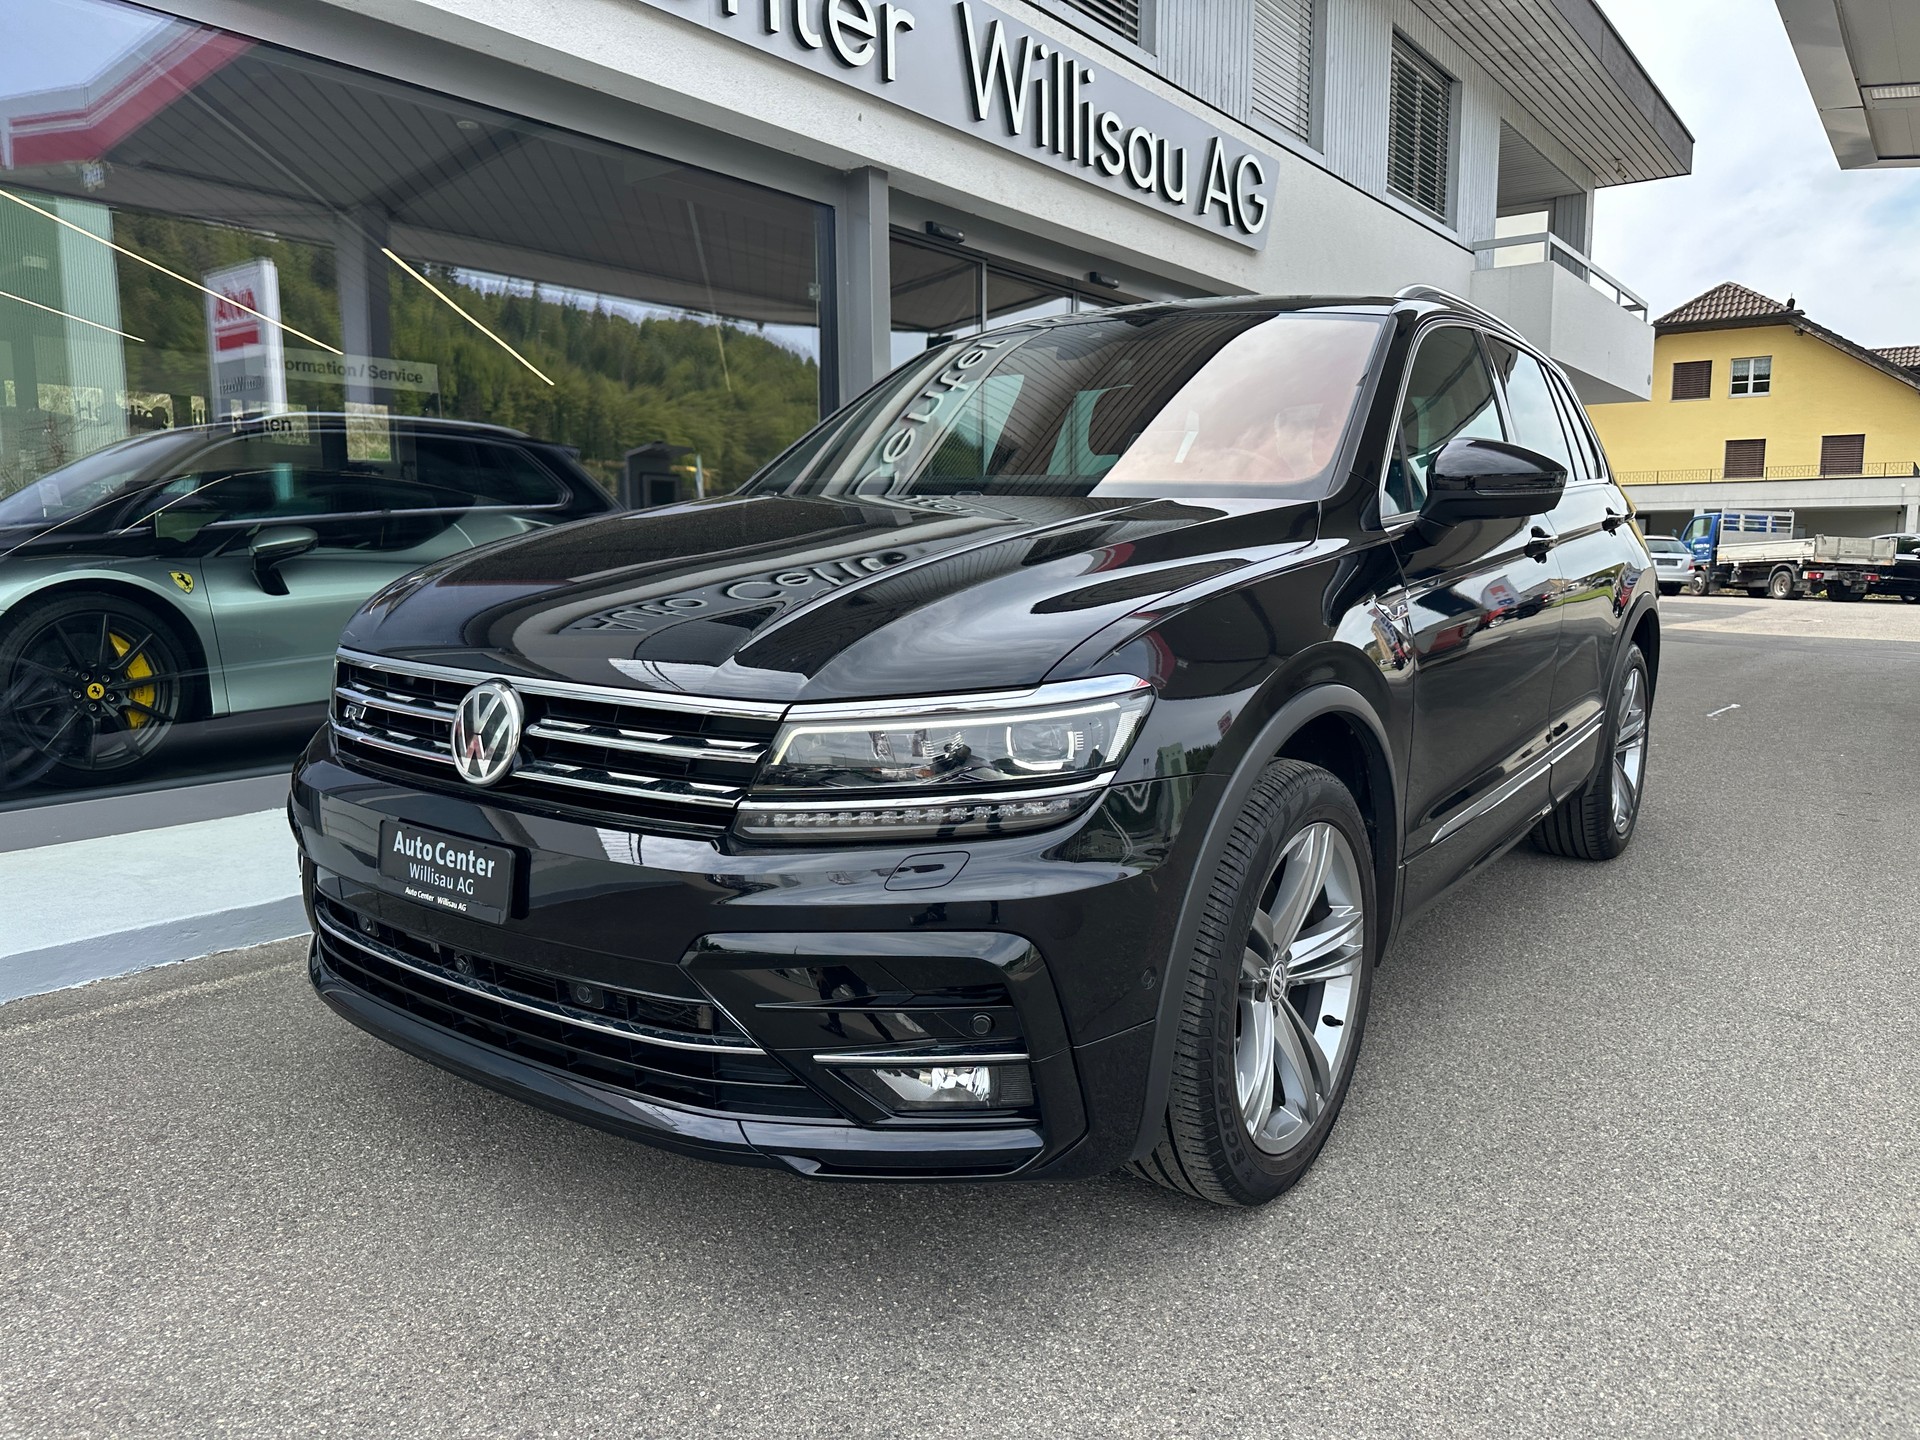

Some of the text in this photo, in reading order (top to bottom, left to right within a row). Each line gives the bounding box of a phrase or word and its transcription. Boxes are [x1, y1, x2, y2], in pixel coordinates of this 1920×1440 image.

[956, 1, 1188, 205] Willisau
[1198, 136, 1268, 235] AG
[368, 363, 424, 384] Service
[409, 862, 474, 895] Willisau AG
[405, 886, 467, 912] Auto Center Willisau AG
